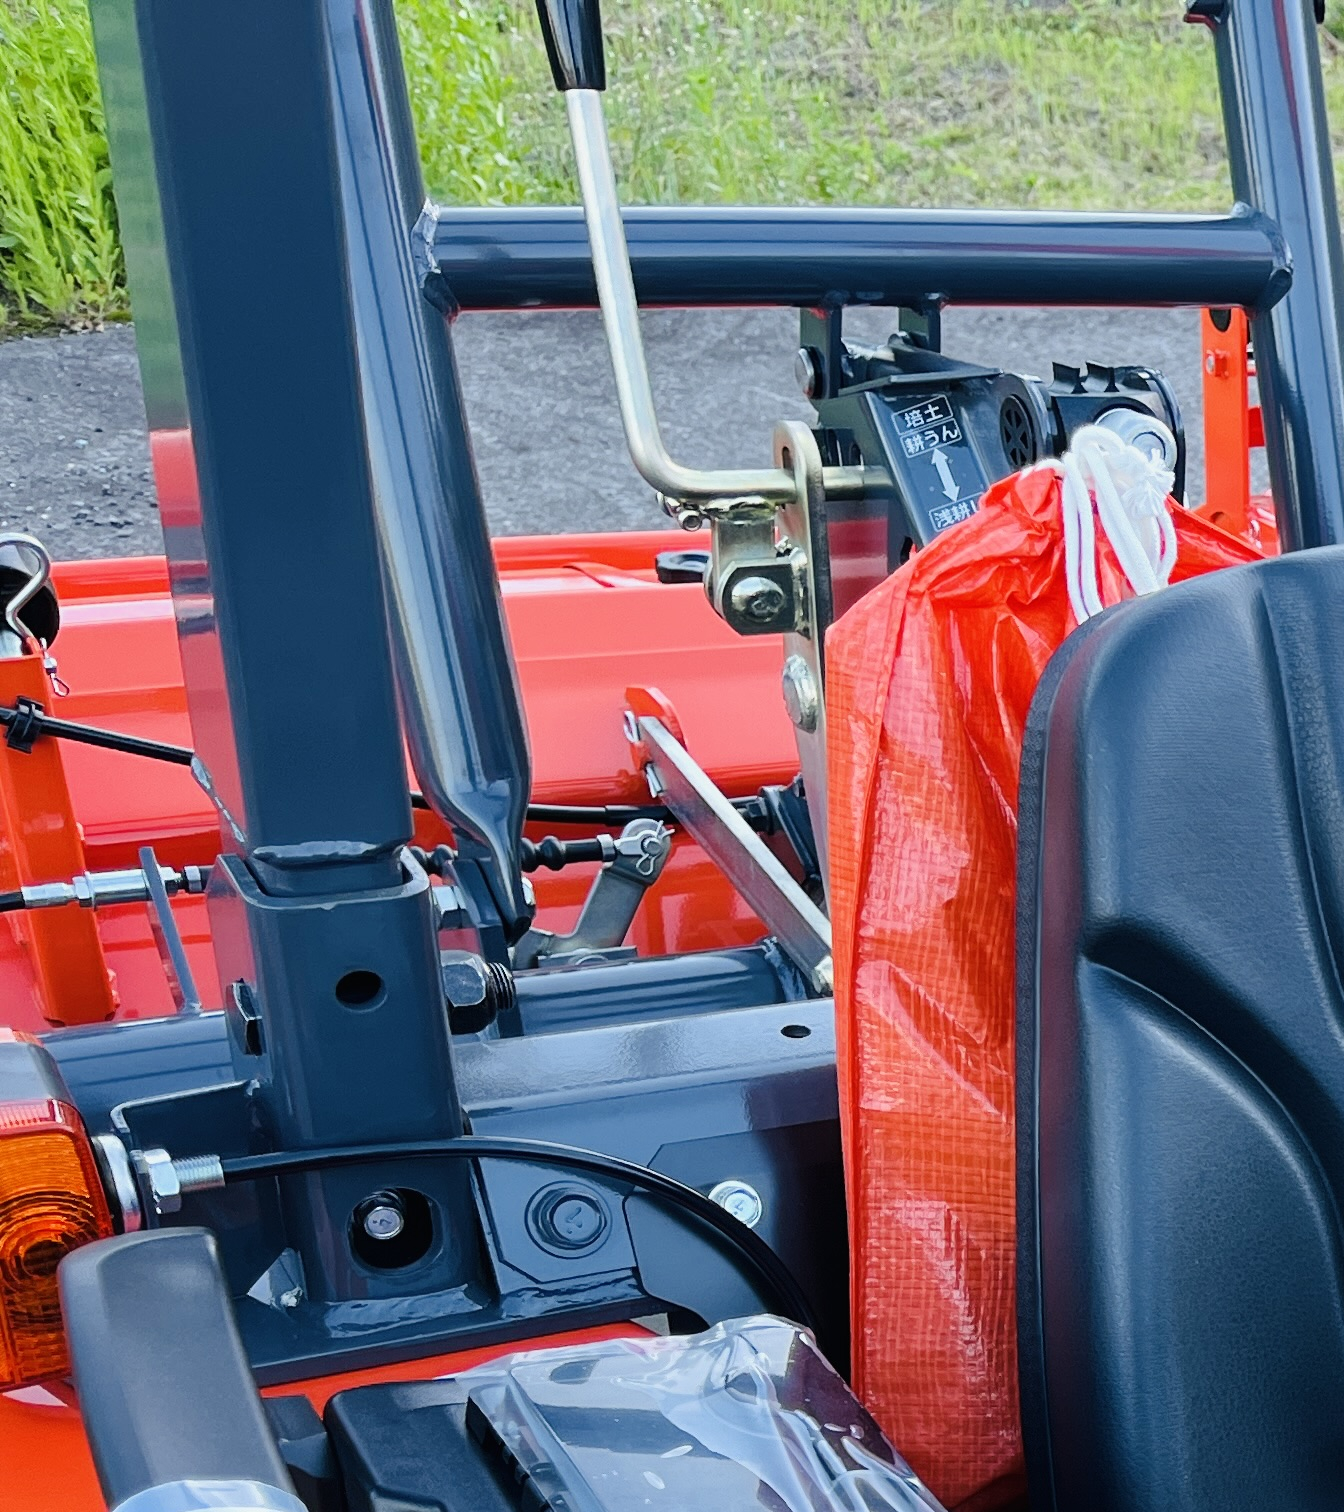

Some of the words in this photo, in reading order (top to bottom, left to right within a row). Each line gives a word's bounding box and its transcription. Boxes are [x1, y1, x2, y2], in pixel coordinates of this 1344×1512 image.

[904, 403, 944, 428] 培土
[905, 425, 959, 455] 耕うん
